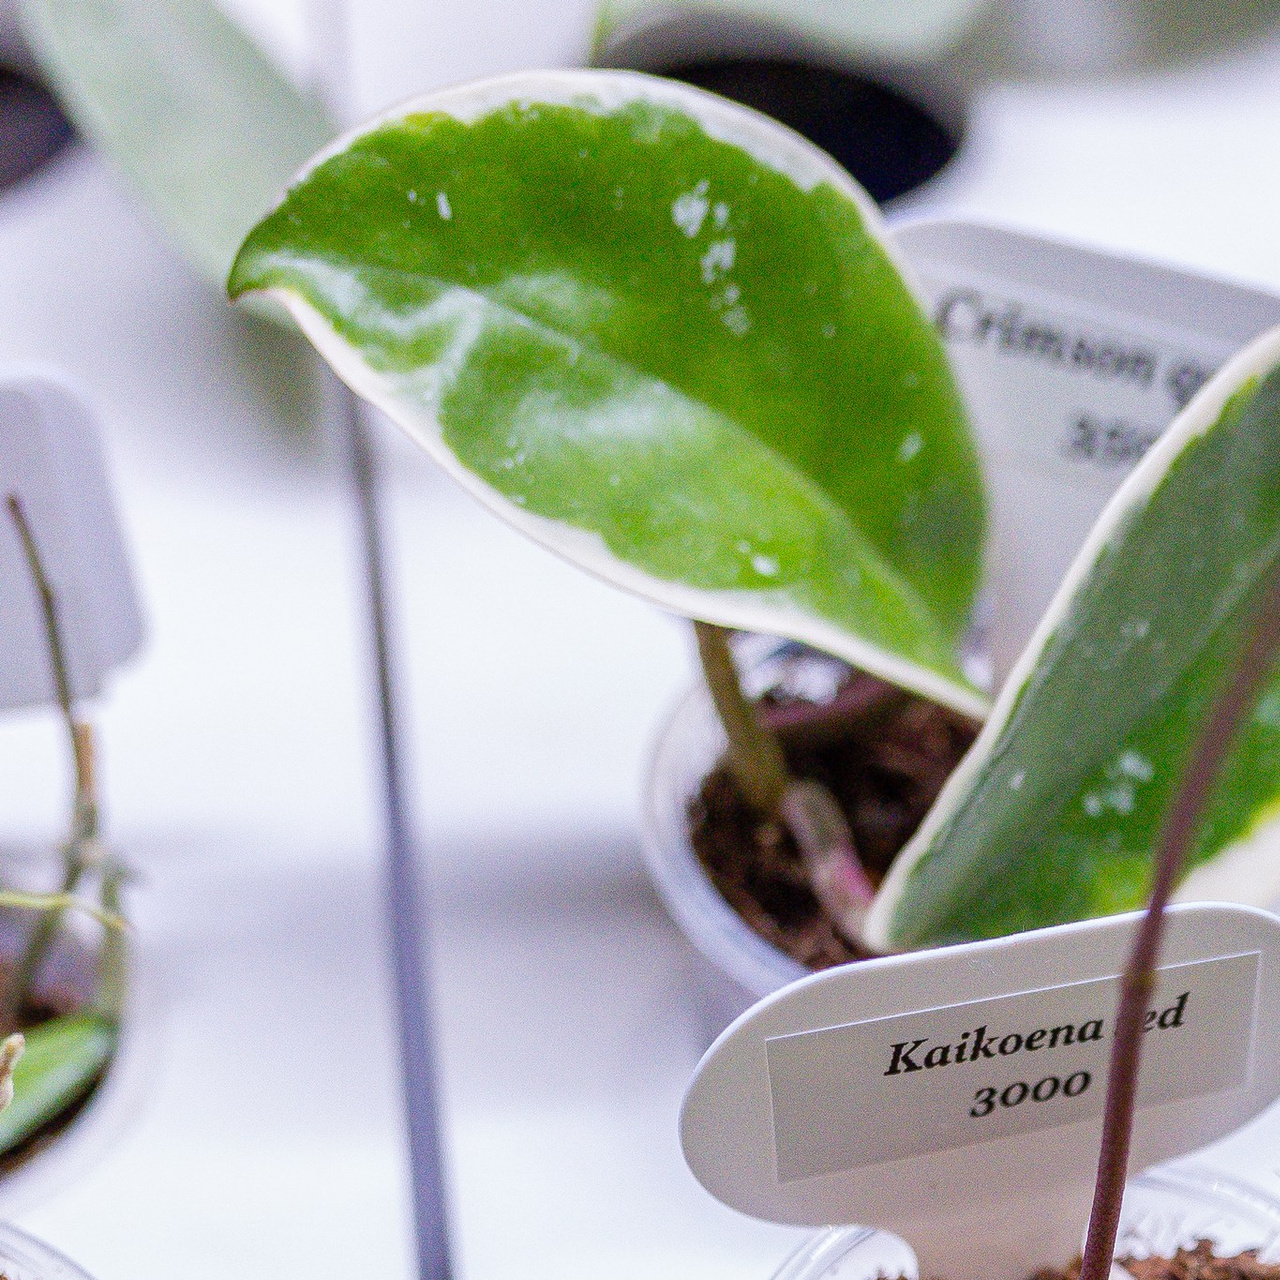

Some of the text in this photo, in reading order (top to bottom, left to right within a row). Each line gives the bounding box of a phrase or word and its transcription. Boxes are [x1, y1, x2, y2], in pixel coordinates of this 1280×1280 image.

[884, 990, 1190, 1076] Kaikoena ed
[969, 1071, 1091, 1118] 3000
